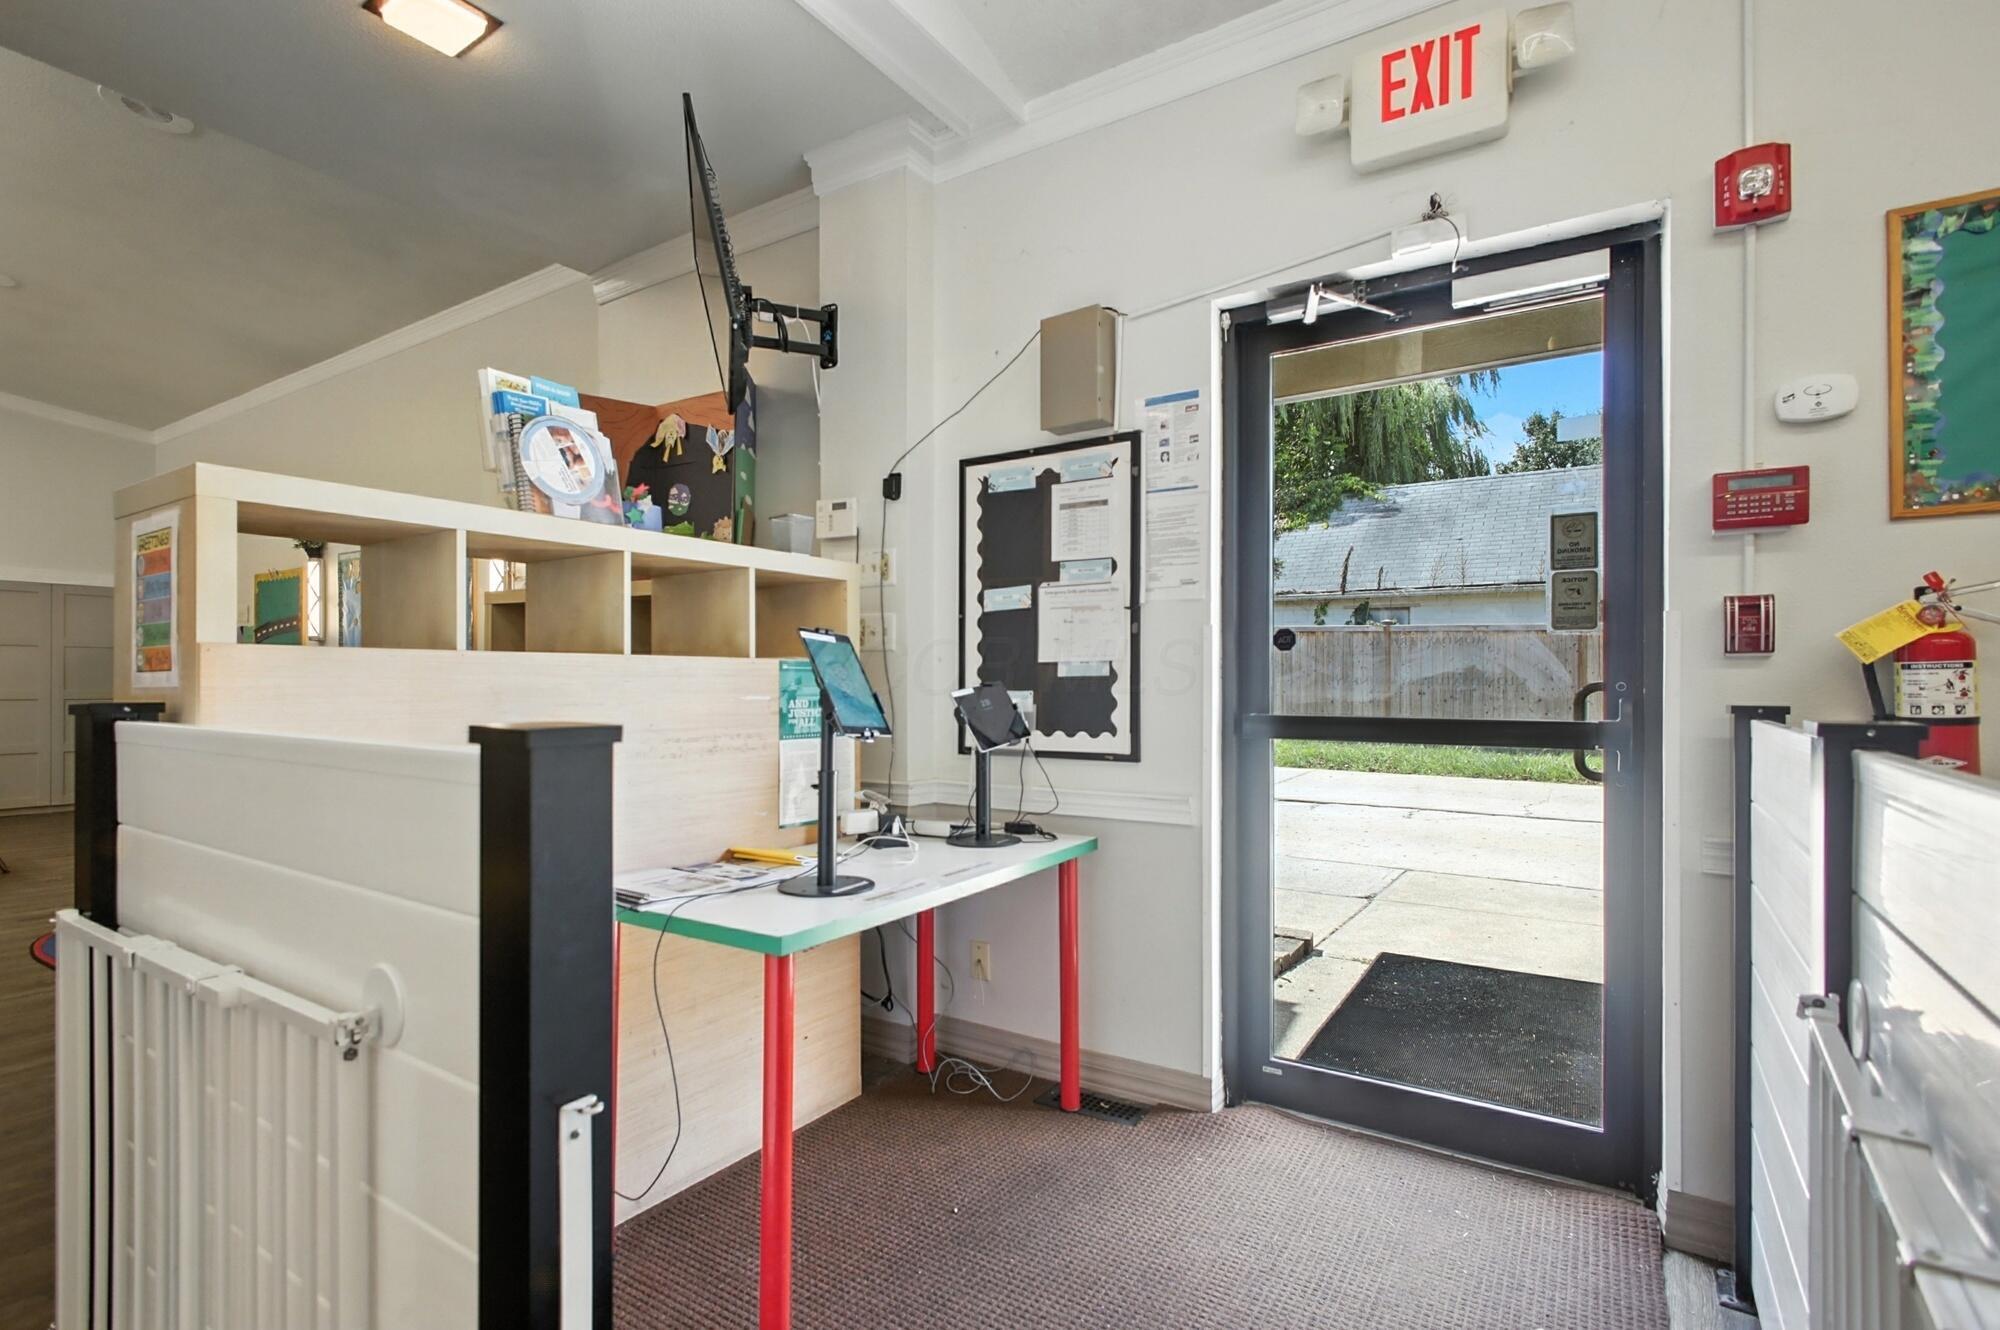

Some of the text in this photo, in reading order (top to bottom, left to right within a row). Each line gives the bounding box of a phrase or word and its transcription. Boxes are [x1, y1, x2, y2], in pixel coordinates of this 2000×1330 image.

[1381, 24, 1481, 123] EXIT
[788, 699, 809, 708] AND
[788, 708, 822, 718] JUSTIC
[798, 718, 816, 727] ALL
